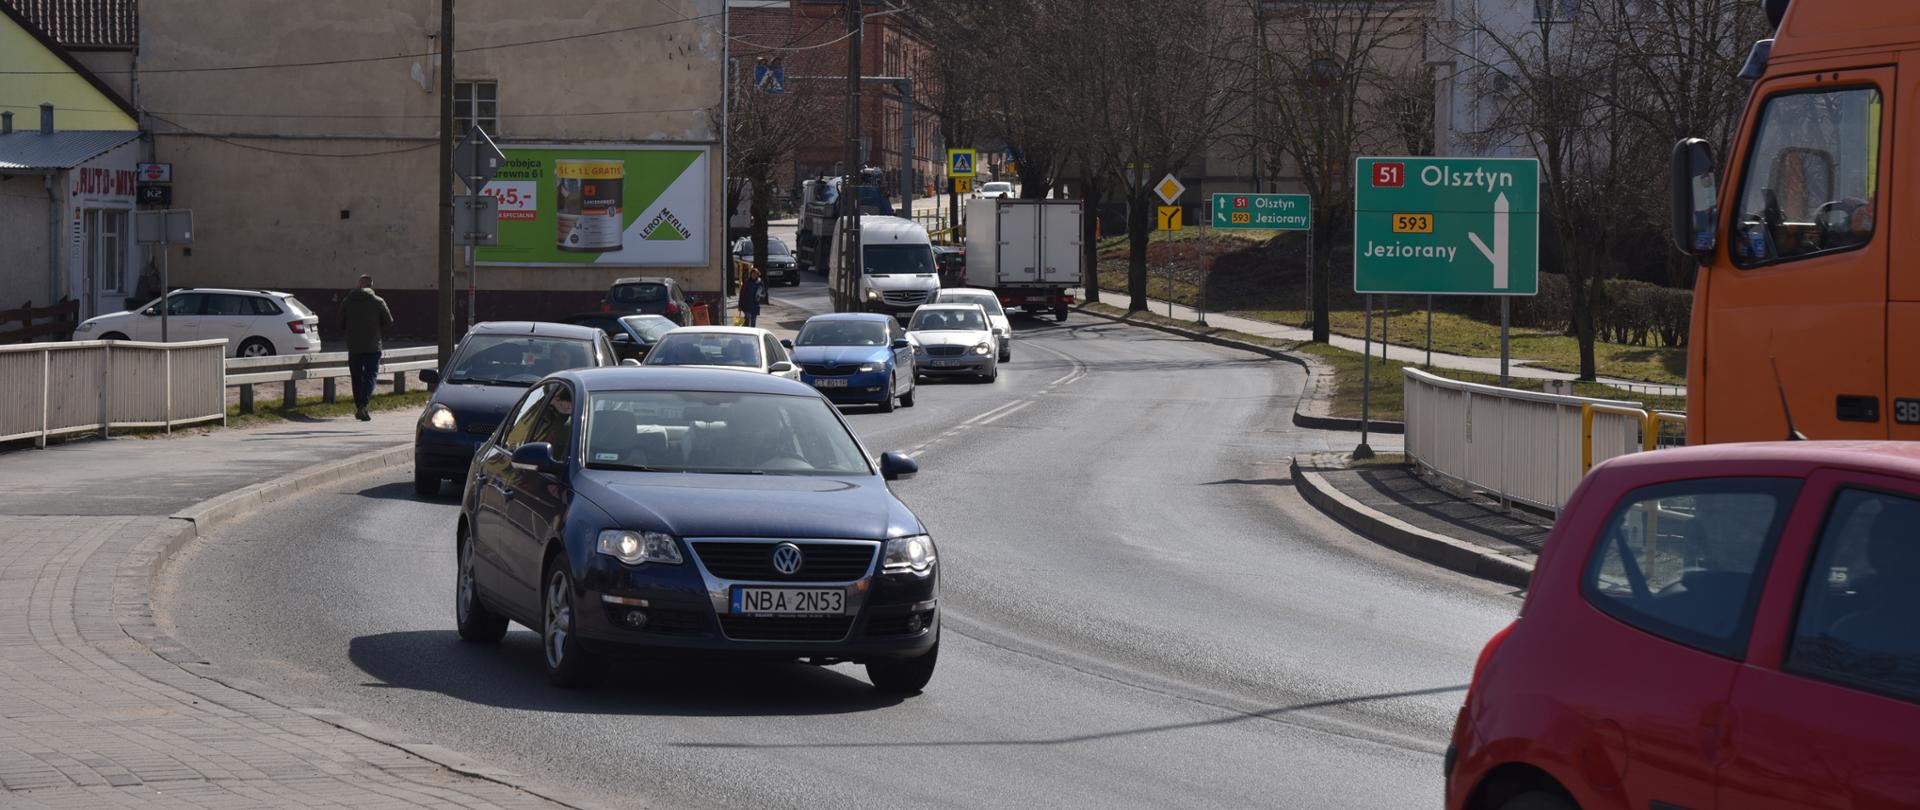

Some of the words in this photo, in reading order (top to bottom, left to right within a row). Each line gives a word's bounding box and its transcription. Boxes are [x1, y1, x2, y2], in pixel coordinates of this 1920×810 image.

[591, 167, 621, 176] GRATIS
[1379, 167, 1397, 183] 51
[1421, 165, 1513, 193] Olsztyn
[146, 188, 162, 198] K2
[1236, 199, 1246, 207] 51
[1255, 197, 1295, 211] Olsztyn
[639, 213, 664, 240] LEROY
[660, 207, 692, 239] MERLIN
[1233, 213, 1249, 222] 593
[1255, 213, 1307, 226] Jeziorany
[1398, 217, 1428, 230] 593
[1364, 241, 1457, 263] Jeziorany
[745, 591, 787, 611] NBA
[795, 591, 842, 611] 2N53
